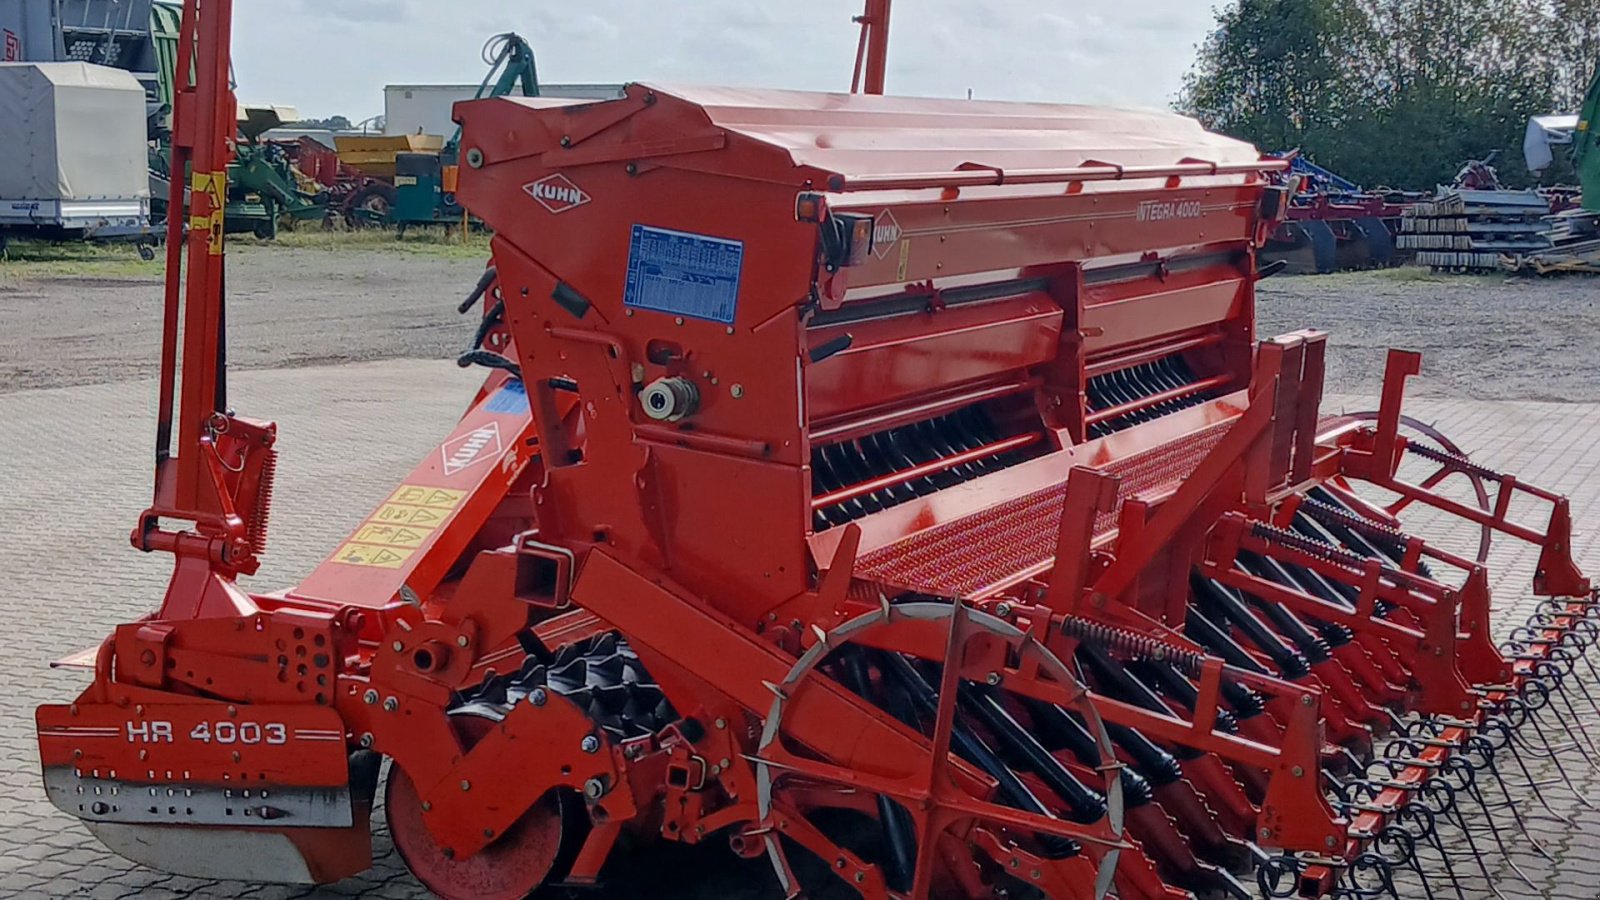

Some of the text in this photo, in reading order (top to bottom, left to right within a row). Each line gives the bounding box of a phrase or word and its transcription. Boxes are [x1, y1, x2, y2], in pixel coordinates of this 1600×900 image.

[532, 182, 581, 204] KUHN
[1136, 201, 1200, 221] INTEGRA 4000
[446, 428, 497, 468] KUHN
[126, 720, 287, 744] HR 4003
